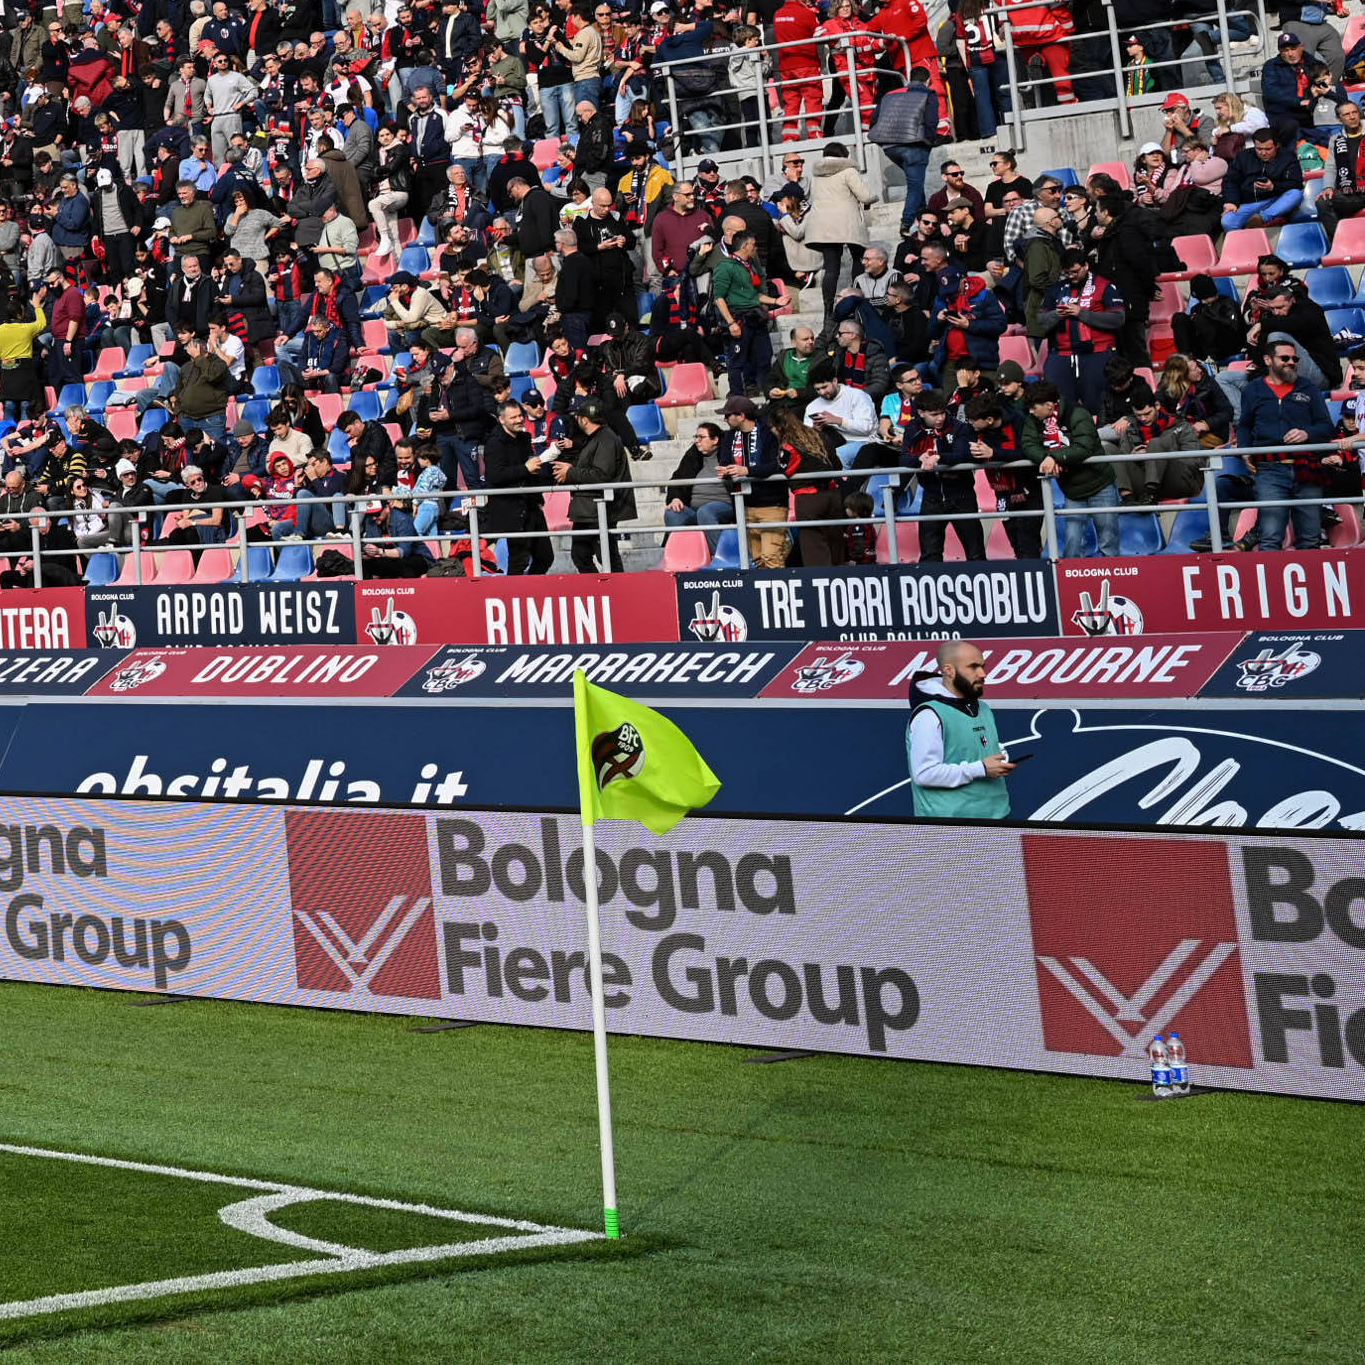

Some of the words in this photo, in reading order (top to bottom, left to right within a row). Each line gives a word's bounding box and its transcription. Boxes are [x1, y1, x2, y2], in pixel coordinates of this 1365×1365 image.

[684, 580, 720, 589] BOLOGNA
[723, 579, 743, 588] CLUB
[1065, 569, 1110, 577] BOLOGNA
[1112, 566, 1138, 575] CLUB
[362, 588, 395, 596] BOLOGNA
[397, 587, 415, 595] CLUB
[754, 579, 805, 630] TRE
[812, 577, 893, 627] TORRI
[902, 572, 1046, 626] ROSSOBLU
[1182, 561, 1352, 622] FRIGN
[156, 591, 243, 635] ARPAD
[259, 589, 340, 634] WEISZ
[485, 595, 612, 644] RIMINI
[1259, 634, 1305, 642] BOLOGNA
[1307, 633, 1345, 641] CLUB
[191, 654, 379, 683] DUBLINO
[496, 650, 775, 684] MARRAKECH
[617, 740, 635, 752] 1909
[618, 724, 639, 747] BFC
[434, 816, 796, 932] Bologna
[5, 894, 191, 989] Group
[443, 921, 632, 1009] Fiere
[652, 932, 922, 1053] Group
